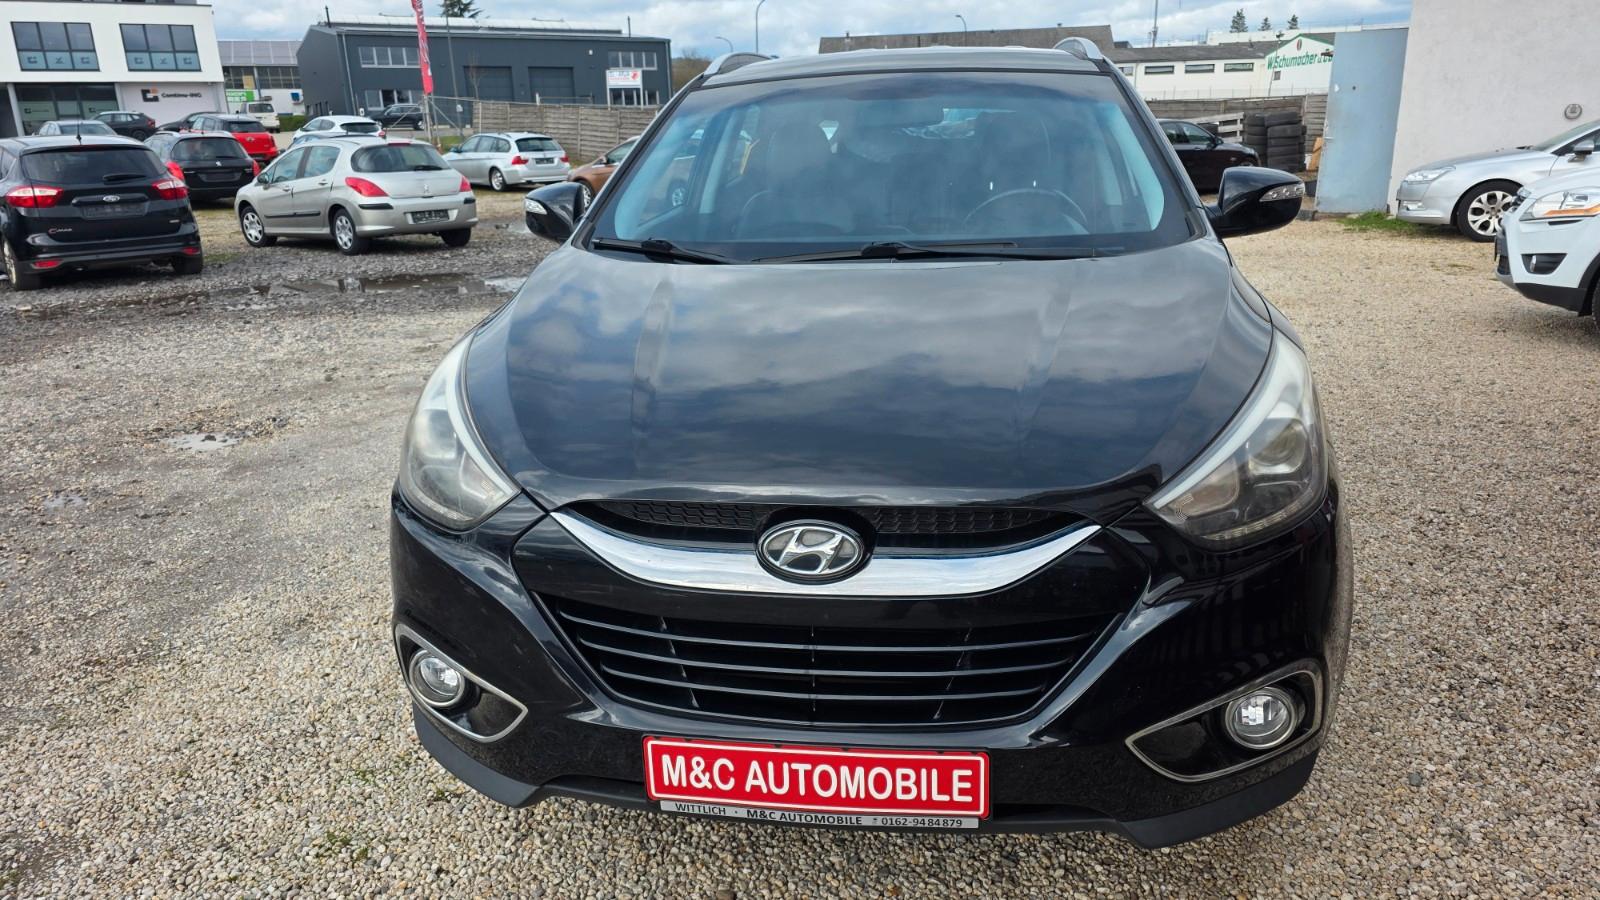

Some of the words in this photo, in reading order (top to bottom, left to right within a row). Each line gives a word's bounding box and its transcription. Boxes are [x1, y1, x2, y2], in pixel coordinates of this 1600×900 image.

[661, 753, 736, 791] M&C
[745, 760, 973, 803] AUTOMOBILE
[675, 803, 726, 815] WITTLICH
[746, 809, 777, 820] M&C
[779, 812, 863, 825] AUTOMOBILE
